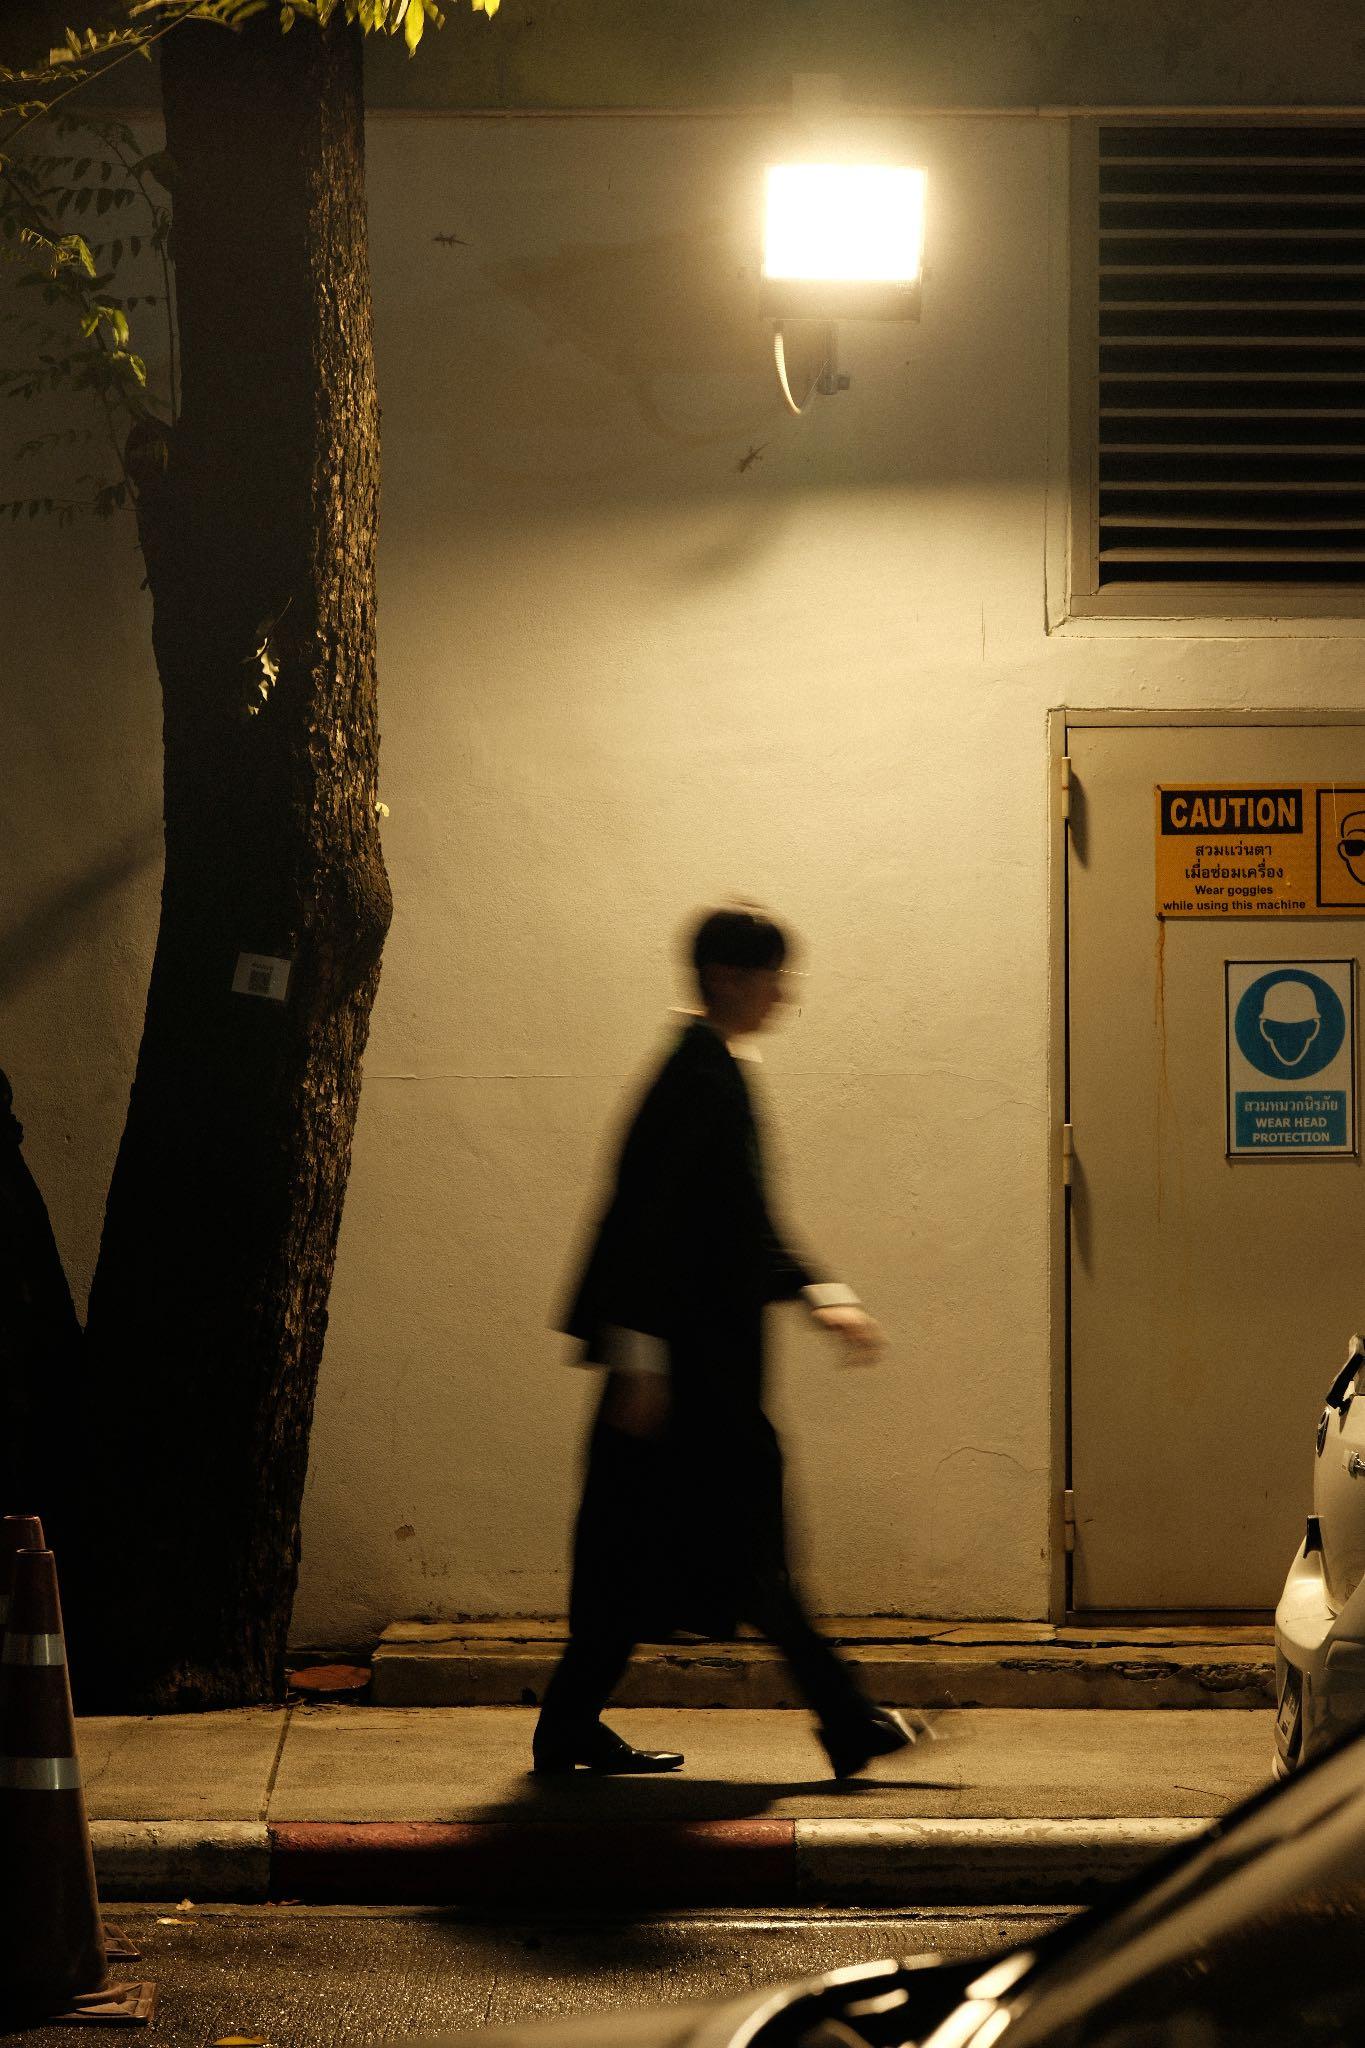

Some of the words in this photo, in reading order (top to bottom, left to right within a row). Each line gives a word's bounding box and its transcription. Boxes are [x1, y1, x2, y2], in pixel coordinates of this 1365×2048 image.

[1170, 797, 1296, 828] CAUTION
[1195, 841, 1272, 856] สวมแว่นตา
[1184, 859, 1284, 878] เมื่อซ่อมเครื่อง
[1194, 885, 1224, 895] Wear
[1227, 885, 1273, 897] goggles
[1163, 901, 1193, 911] while
[1197, 900, 1228, 912] using
[1232, 900, 1253, 910] this
[1256, 900, 1306, 910] machine
[1255, 1117, 1291, 1128] WEAR
[1294, 1117, 1327, 1128] HEAD
[1252, 1132, 1330, 1143] PROTECTION
